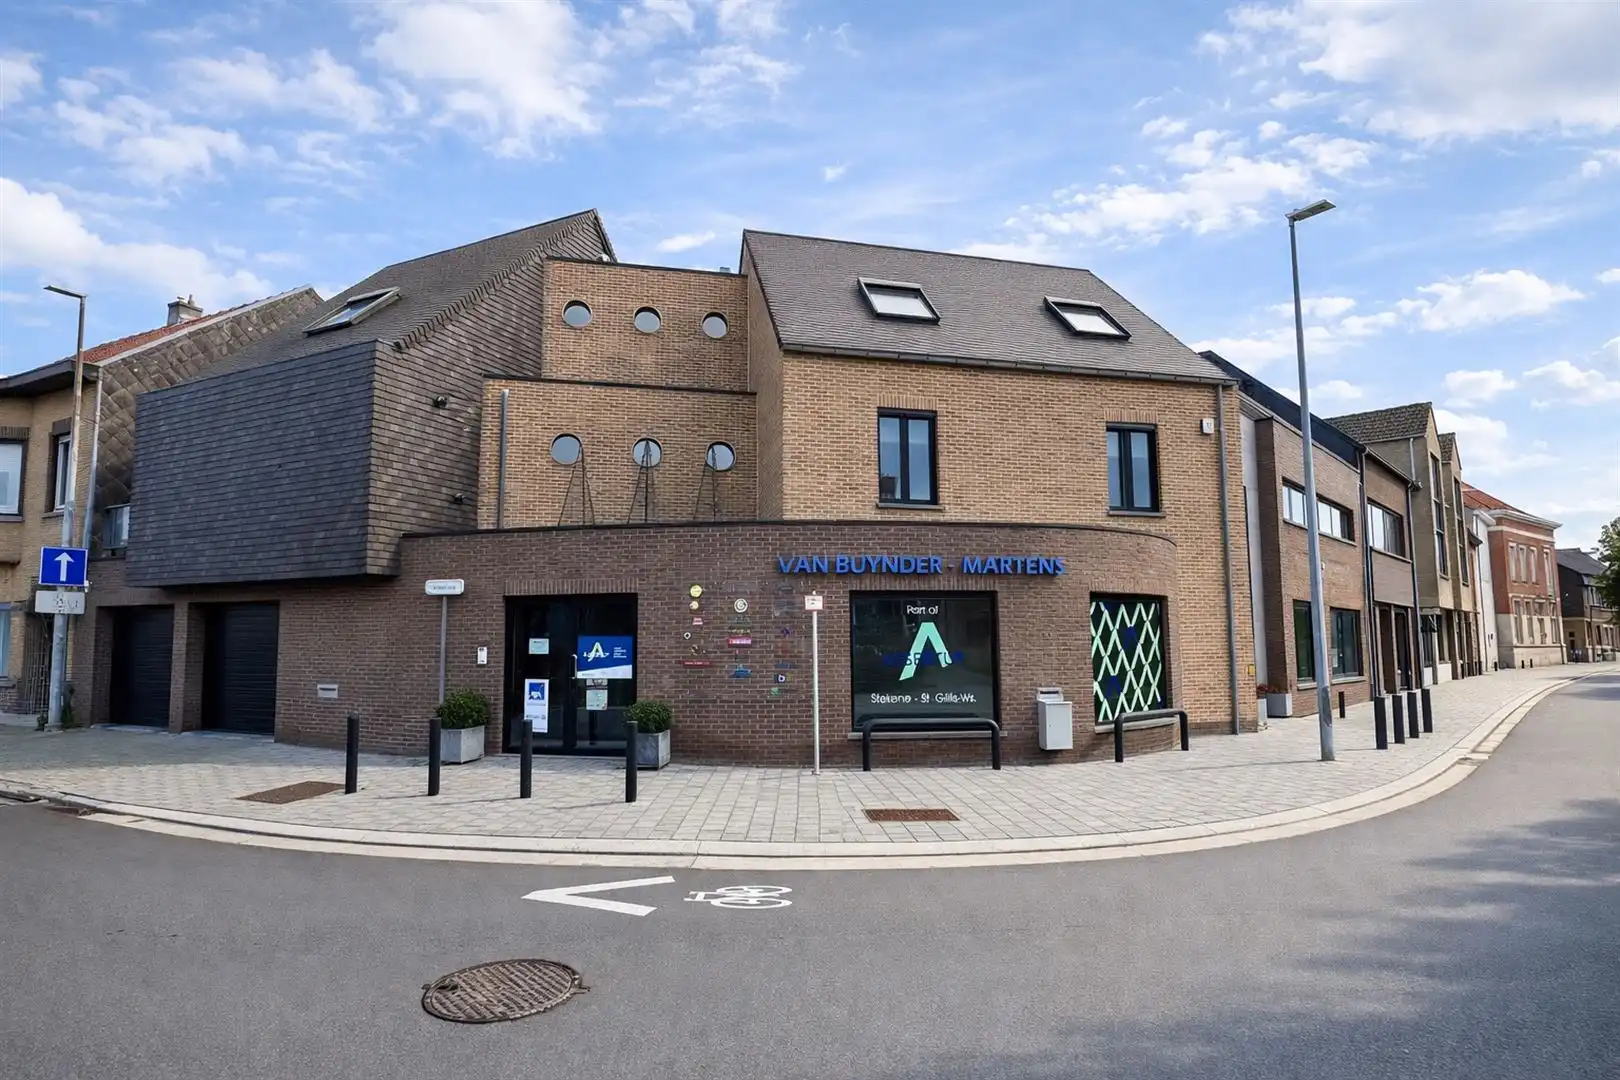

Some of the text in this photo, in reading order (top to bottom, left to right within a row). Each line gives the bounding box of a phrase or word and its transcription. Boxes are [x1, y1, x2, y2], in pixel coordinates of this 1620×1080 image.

[778, 555, 828, 574] VAN
[835, 555, 942, 574] BUYNDER
[962, 555, 1065, 575] MARTENS
